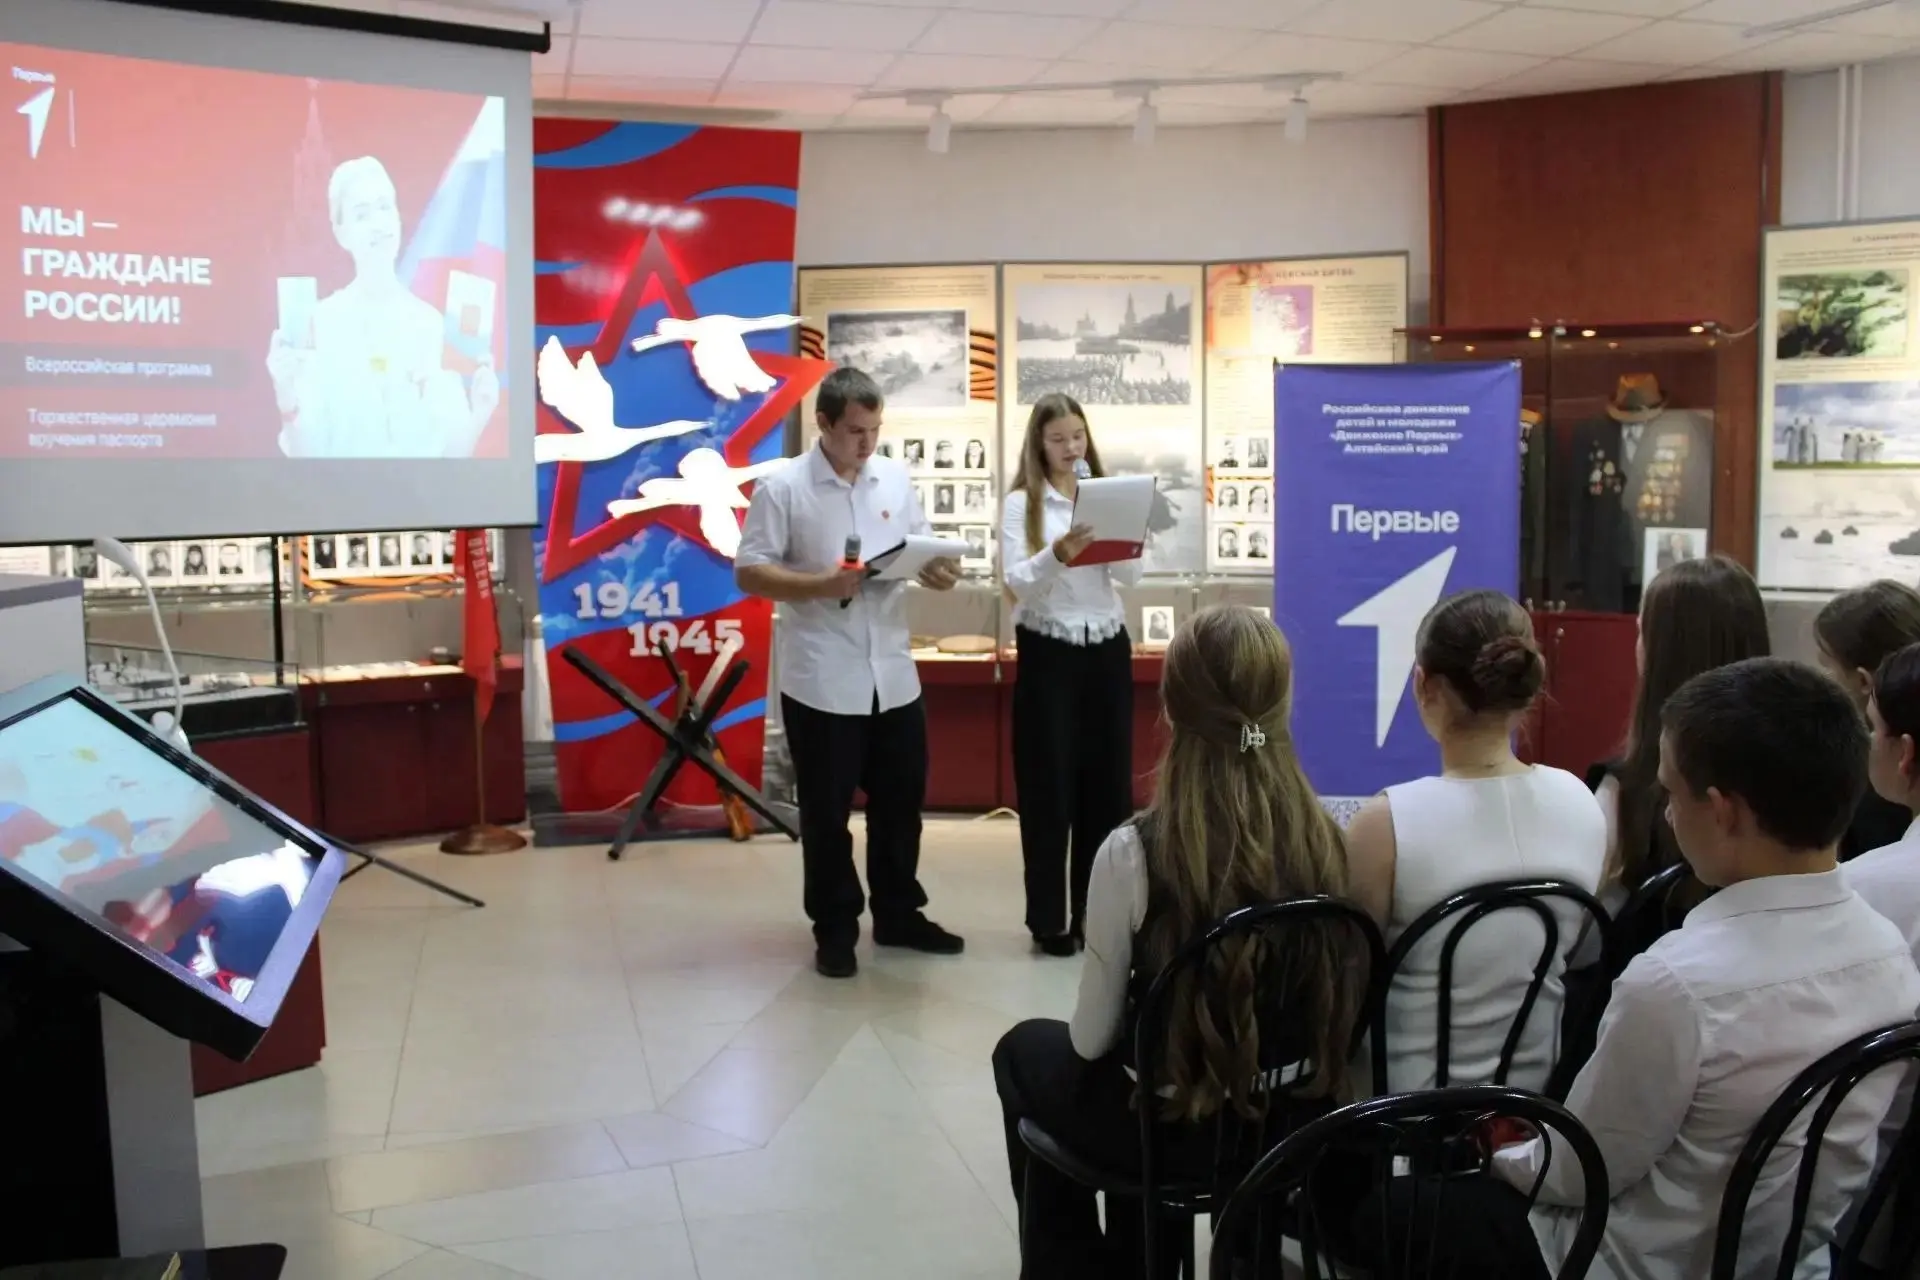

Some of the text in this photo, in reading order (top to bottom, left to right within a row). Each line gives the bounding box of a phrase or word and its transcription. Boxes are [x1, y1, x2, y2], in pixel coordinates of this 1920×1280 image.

[20, 205, 85, 237] МЫ
[22, 247, 212, 287] ГРАЖДАНЕ
[24, 290, 181, 324] РОССИИ!
[25, 356, 212, 377] Всероссийская программа
[27, 408, 217, 428] Торжественная церемония
[1322, 403, 1470, 415] Российское движение
[1335, 417, 1456, 428] детей и молодежи
[28, 433, 163, 449] вручения паспорта
[1329, 430, 1464, 441] «Движение Первых»
[1344, 443, 1449, 455] Алтайский край
[1331, 504, 1460, 541] Первые
[573, 581, 684, 619] 1941
[628, 619, 745, 657] 1945
